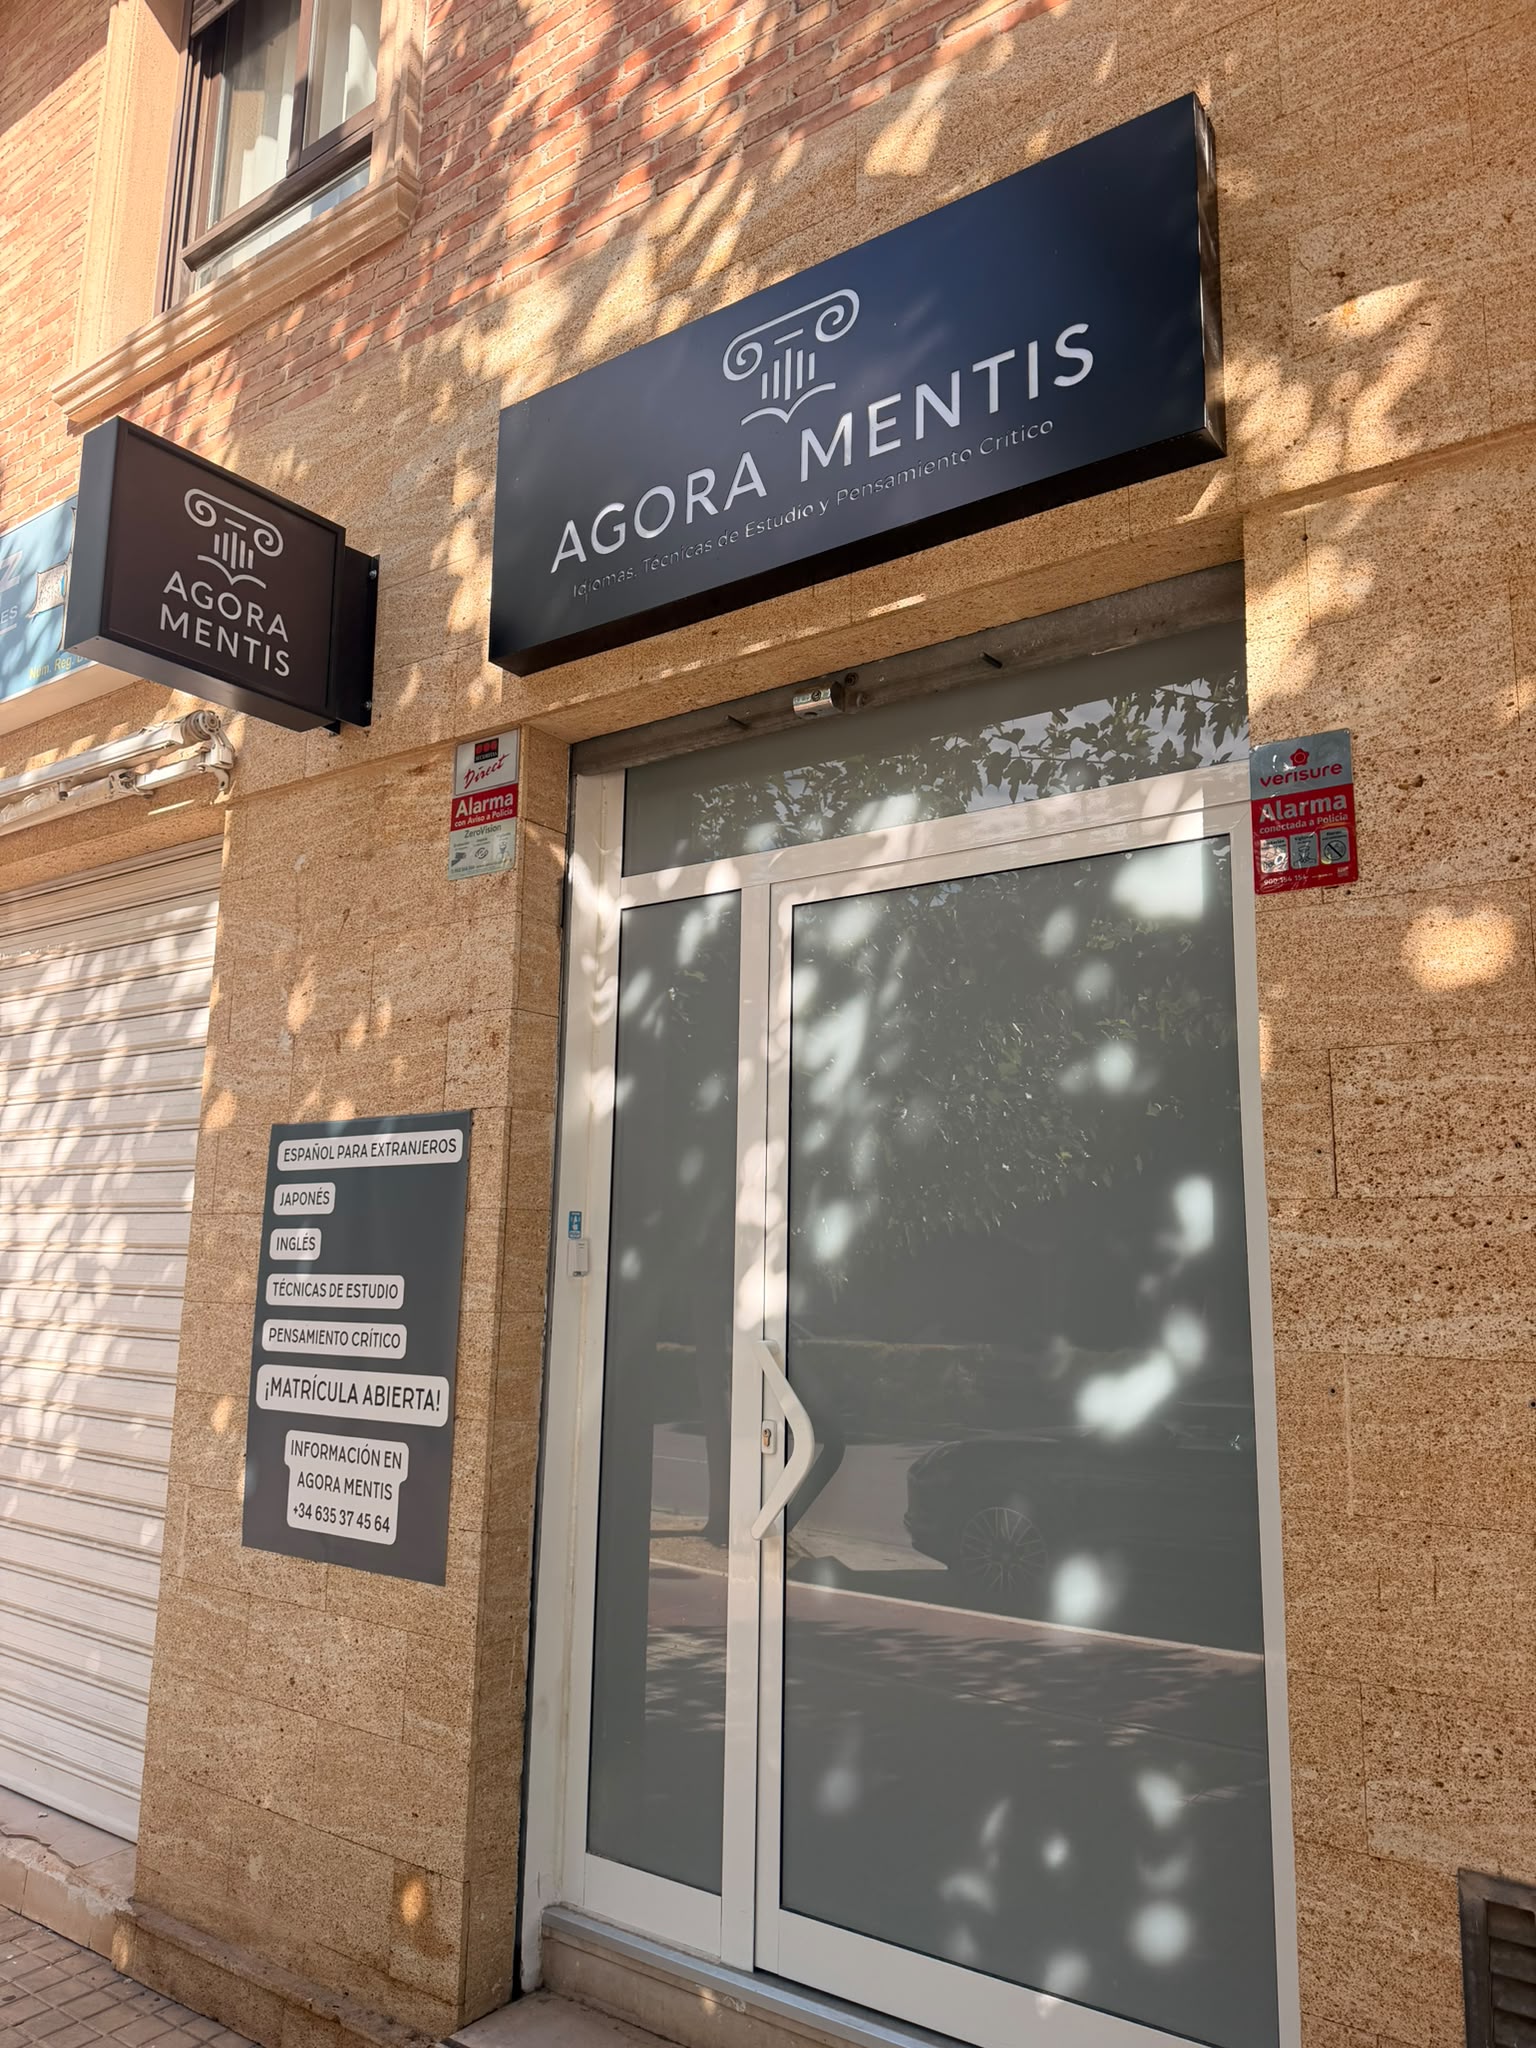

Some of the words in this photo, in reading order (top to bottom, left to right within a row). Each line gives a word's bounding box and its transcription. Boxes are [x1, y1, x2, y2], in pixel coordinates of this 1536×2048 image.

[550, 451, 767, 573] AGORA
[800, 323, 1094, 482] MENTIS
[643, 540, 713, 573] Técnicas
[717, 528, 739, 548] de
[744, 503, 814, 538] Estudio
[819, 498, 829, 516] y
[836, 447, 972, 505] Pensamiento
[163, 570, 289, 643] AGORA
[160, 602, 290, 677] MENTIS
[54, 656, 74, 671] Reg.
[463, 753, 510, 790] Direct
[1259, 763, 1343, 788] verisure
[455, 793, 514, 818] Alarma
[1259, 794, 1348, 824] Alarma
[454, 820, 466, 828] con
[467, 815, 485, 825] Aviso
[1259, 820, 1308, 834] conectada
[1309, 819, 1315, 827] a
[283, 1143, 335, 1162] ESPAÑOL
[337, 1143, 369, 1159] PARA
[371, 1138, 457, 1157] EXTRANJEROS
[280, 1187, 330, 1206] JAPONÉS
[276, 1232, 316, 1251] INGLÉS
[273, 1278, 327, 1297] TÉCNICAS
[329, 1283, 344, 1298] DE
[346, 1283, 399, 1300] ESTUDIO
[268, 1327, 349, 1346] PENSAMIENTO
[351, 1328, 401, 1349] CRÍTICO
[265, 1374, 359, 1404] ¡MATRÍCULA
[362, 1385, 441, 1412] ABIERTA!
[290, 1439, 381, 1467] INFORMACIÓN
[383, 1451, 403, 1470] EN
[297, 1471, 341, 1493] AGORA
[343, 1477, 393, 1501] MENTIS
[293, 1502, 313, 1520] +34
[315, 1505, 337, 1524] 635
[339, 1510, 355, 1527] 37
[356, 1512, 372, 1530] 45
[374, 1515, 391, 1534] 64
